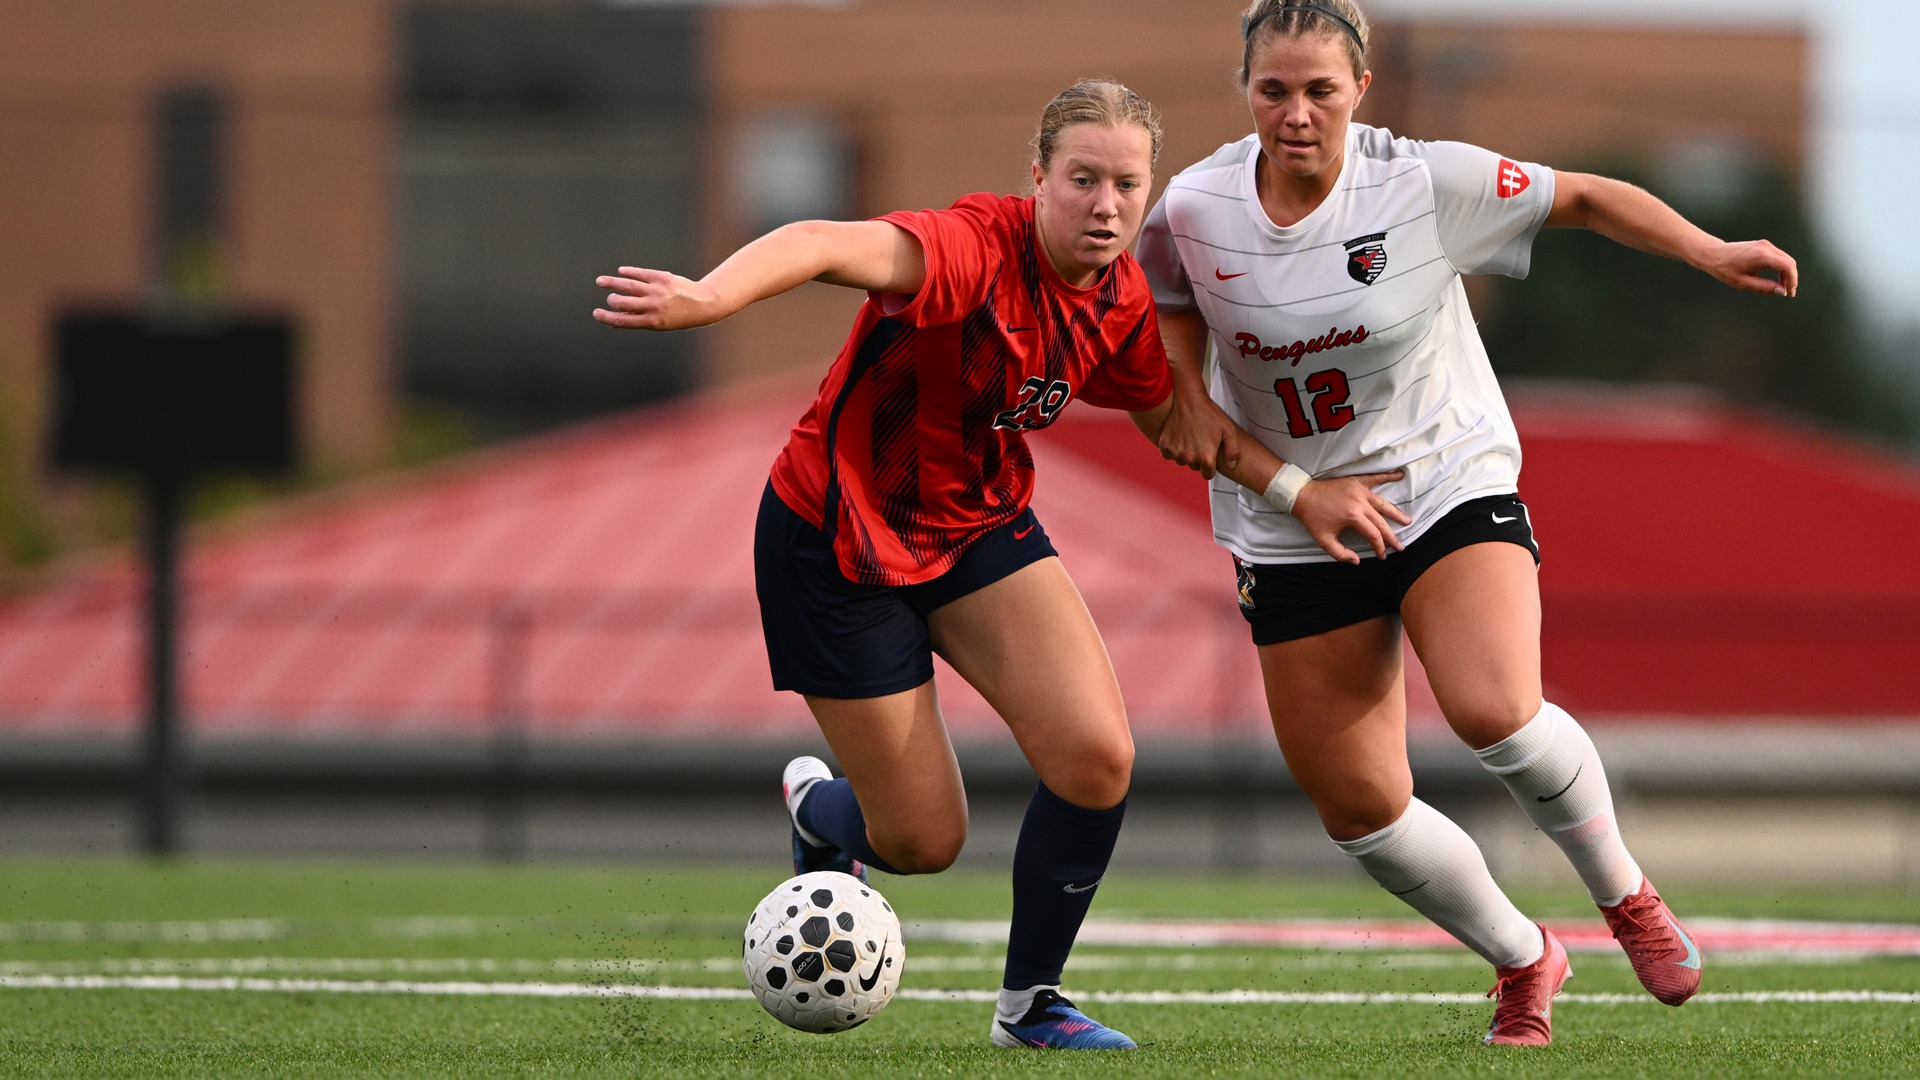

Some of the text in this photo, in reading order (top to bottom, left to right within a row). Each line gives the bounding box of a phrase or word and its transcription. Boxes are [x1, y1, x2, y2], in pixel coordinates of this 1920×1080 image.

[1235, 325, 1370, 367] Penguins
[991, 375, 1071, 432] 29
[1273, 368, 1356, 439] 12
